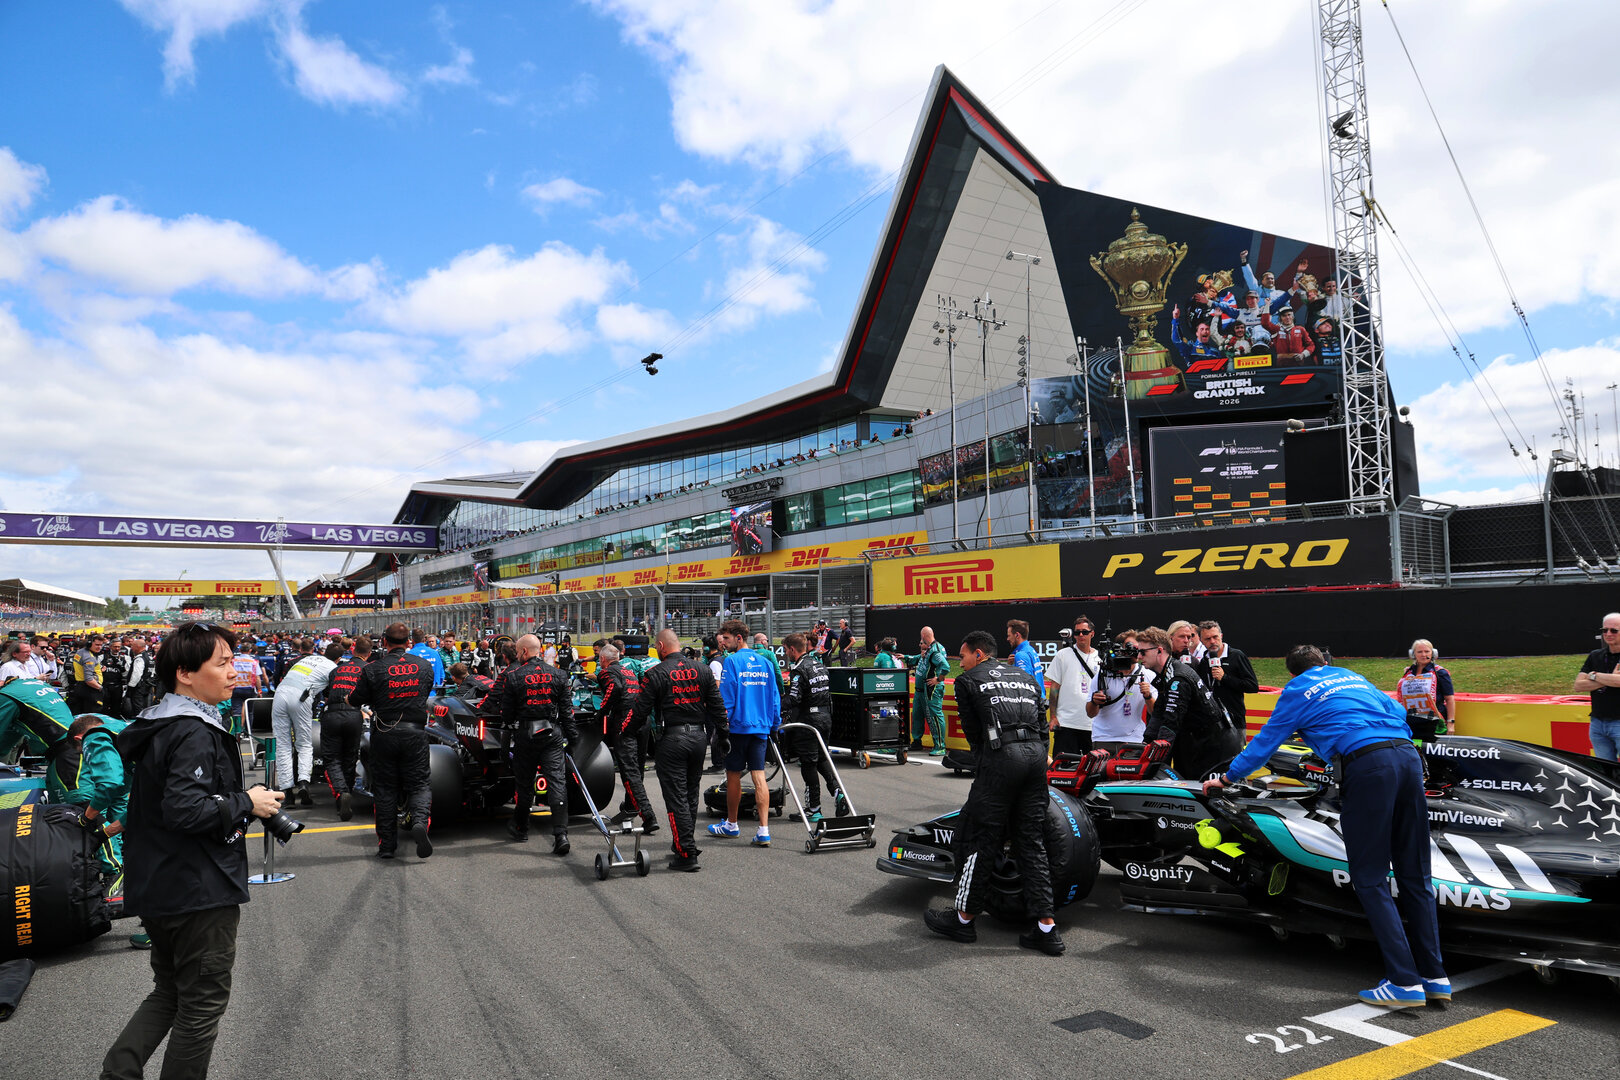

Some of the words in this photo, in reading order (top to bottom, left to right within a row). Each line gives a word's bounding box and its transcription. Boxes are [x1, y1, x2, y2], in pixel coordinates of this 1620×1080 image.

[1237, 357, 1268, 367] PIRELLI
[1206, 378, 1252, 390] BRITISH
[1194, 388, 1235, 399] GRAND
[1236, 386, 1265, 396] PRIX
[32, 517, 75, 537] Vegas
[98, 521, 148, 535] LAS
[153, 522, 235, 538] VEGAS
[312, 527, 353, 541] LAS
[357, 529, 427, 544] VEGAS
[792, 547, 836, 567] DHL
[1102, 552, 1144, 578] P
[1154, 538, 1350, 575] ZERO
[678, 564, 706, 579] DHL
[729, 556, 764, 574] DHL
[634, 570, 658, 585] DHL
[904, 558, 994, 596] PIRELLI
[144, 583, 192, 593] PIRELLI
[216, 583, 262, 593] PIRELLI
[769, 646, 785, 656] 14
[1035, 642, 1057, 656] 18
[388, 679, 419, 688] Revolut
[809, 674, 829, 685] PETRON
[848, 676, 857, 689] 14
[527, 687, 552, 696] Revolut
[672, 684, 700, 693] Revolut
[980, 681, 1037, 694] PETRONAS
[1304, 675, 1364, 700] PETRONAS
[456, 722, 479, 738] Revolut
[1425, 743, 1501, 760] Microsoft
[1305, 771, 1330, 783] AMD
[1472, 779, 1534, 792] SOLERA
[1048, 790, 1066, 804] EFT
[1062, 805, 1081, 838] FRONT
[1160, 802, 1195, 813] AMG
[16, 814, 32, 837] REAR
[1170, 820, 1195, 830] Snapdr
[1427, 809, 1504, 828] amViewer
[933, 828, 953, 845] IW
[903, 850, 935, 862] Microsoft
[15, 884, 31, 920] RIGHT
[16, 922, 32, 946] REAR
[1245, 1025, 1334, 1054] 22
